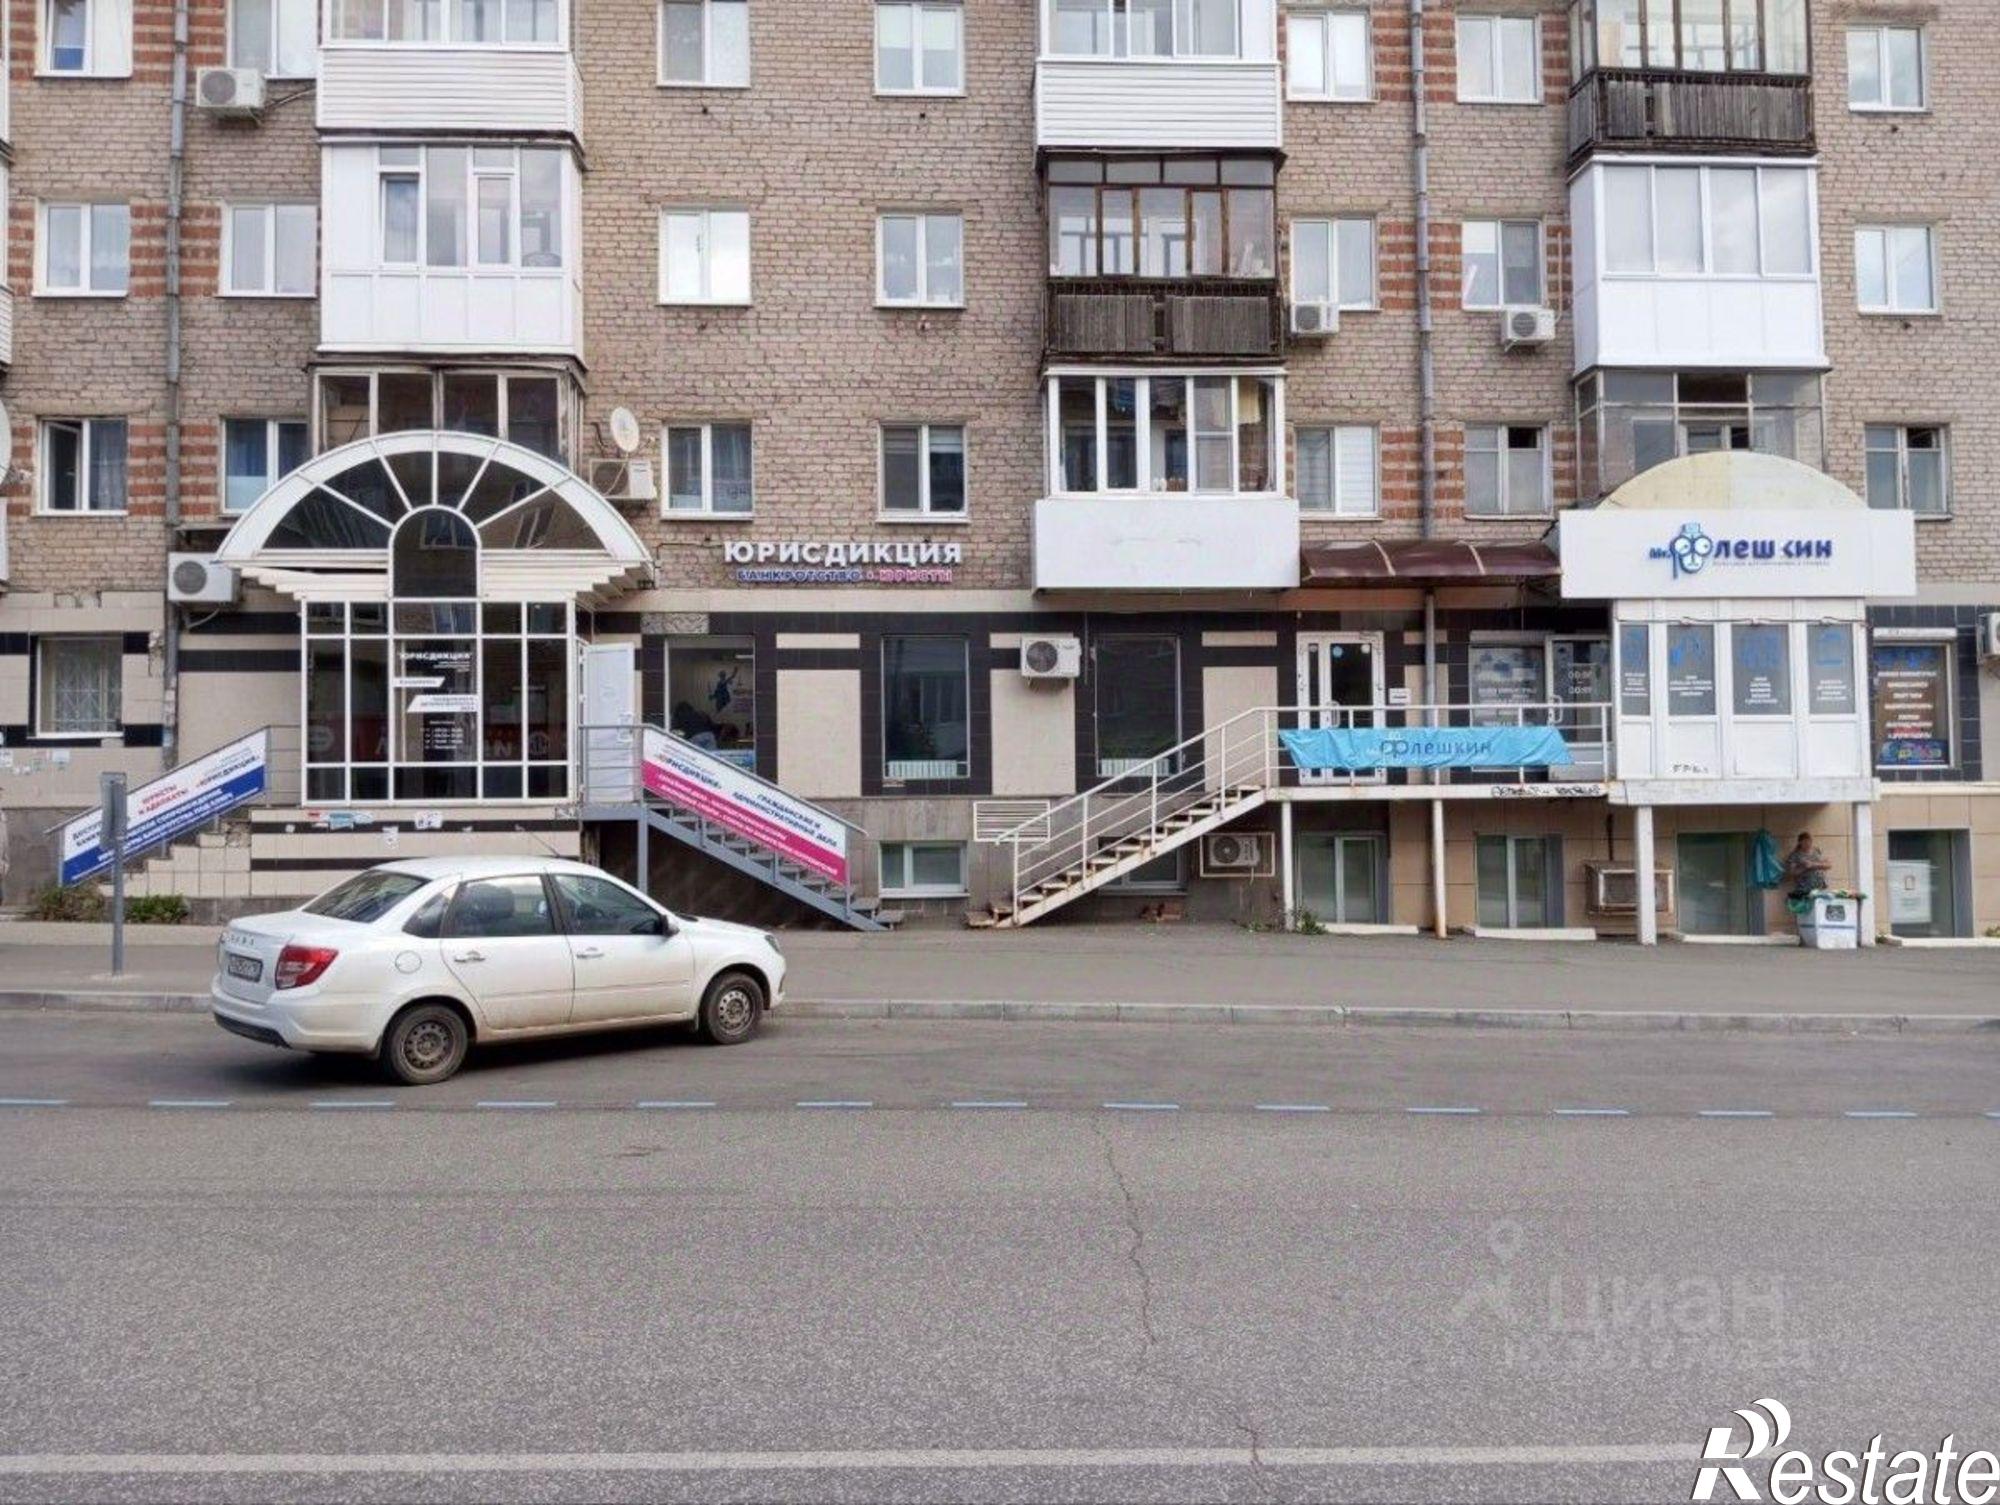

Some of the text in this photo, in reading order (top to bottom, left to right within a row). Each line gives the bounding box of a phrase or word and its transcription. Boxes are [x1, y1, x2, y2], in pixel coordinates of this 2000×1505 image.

[723, 541, 963, 567] ЮРИСДИКЦИЯ
[736, 569, 954, 583] БАНКРОТСТВО ЮРИСТЫ
